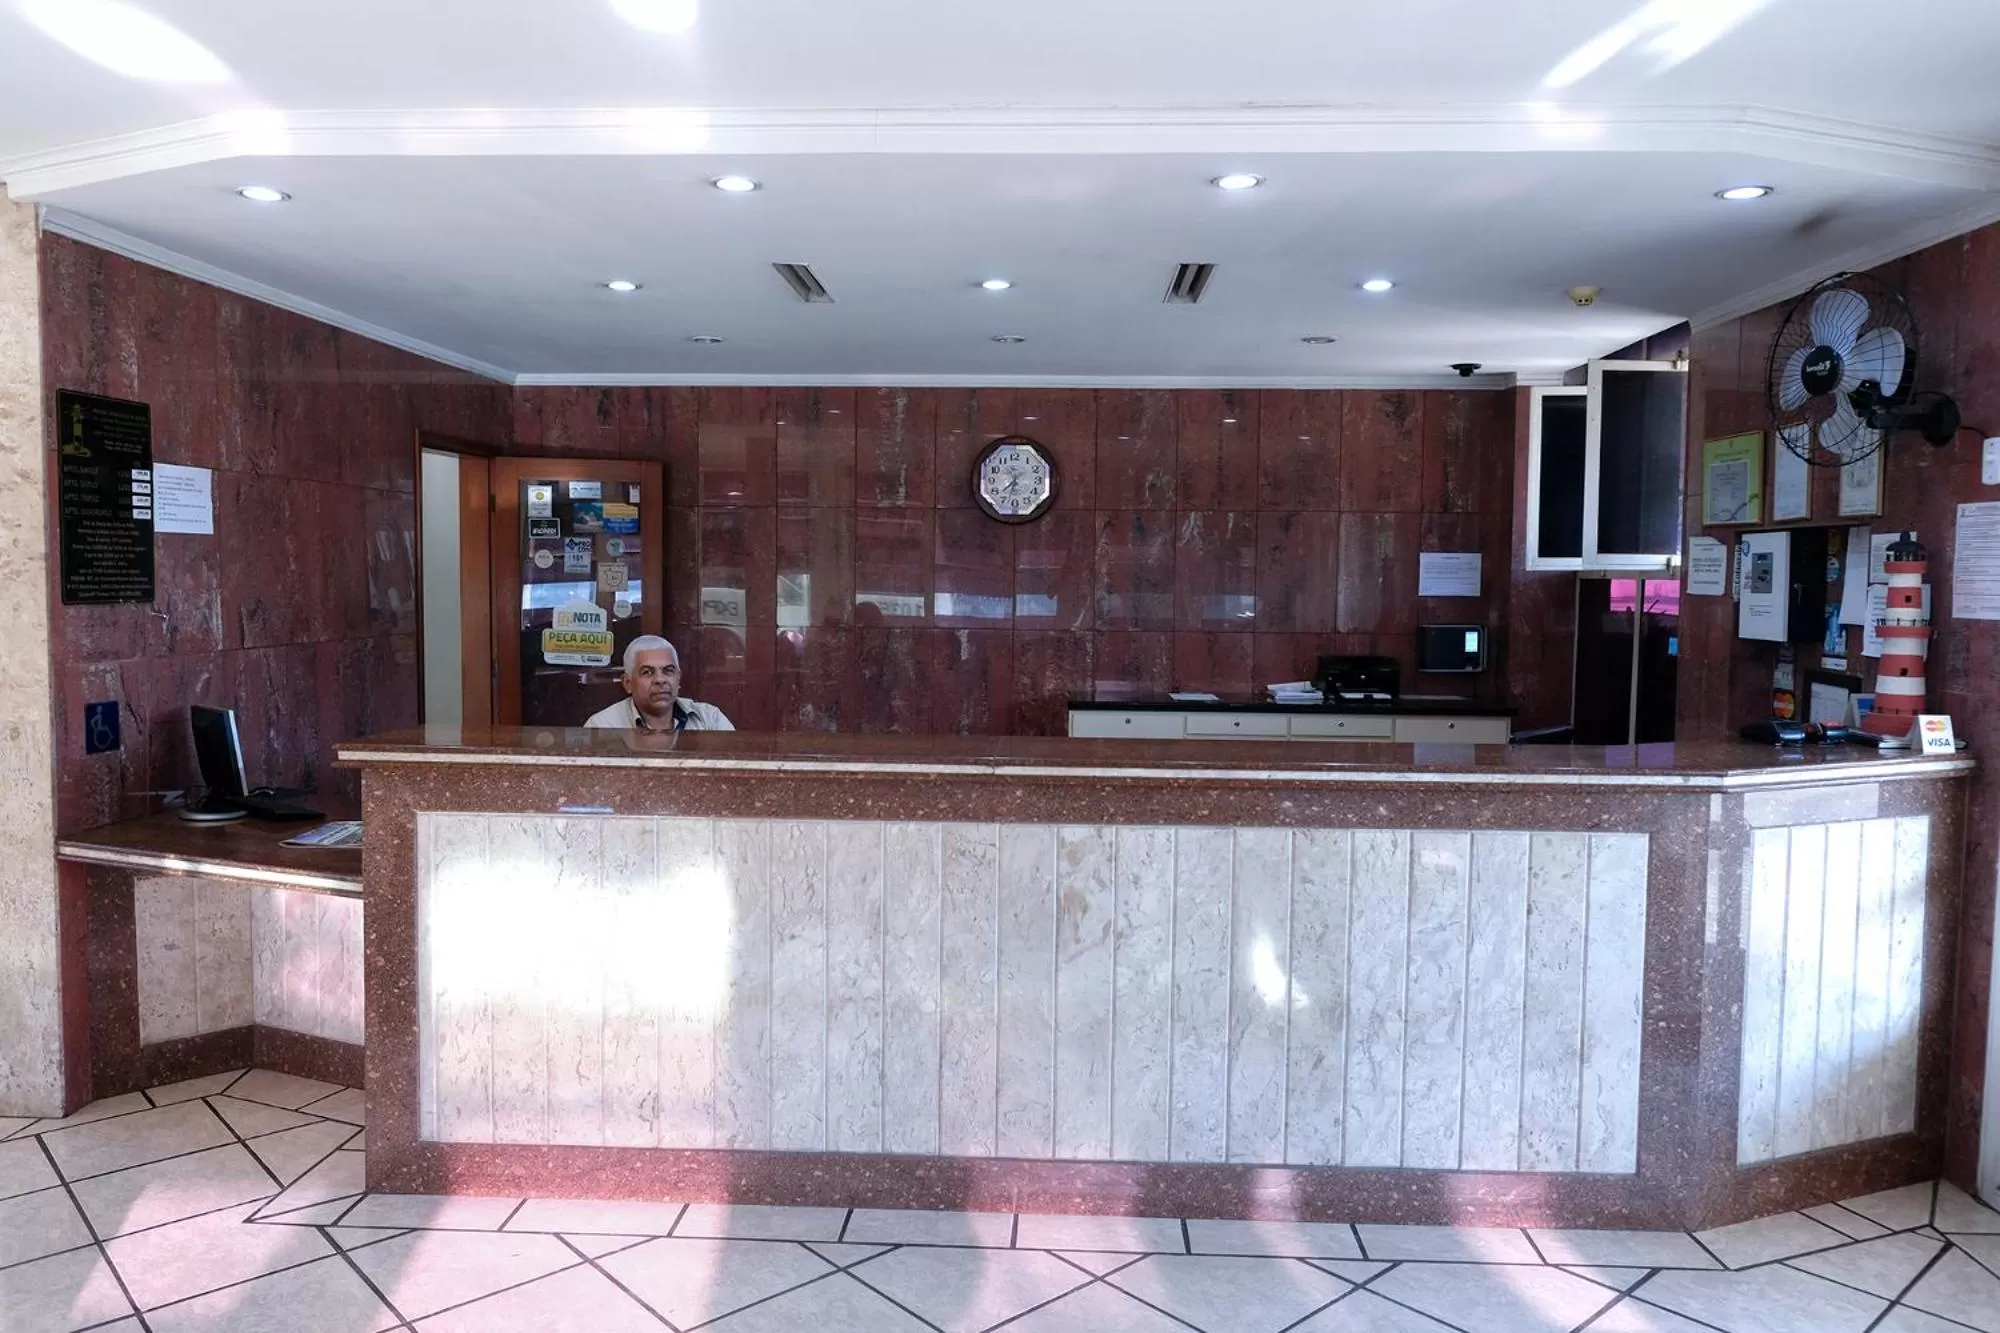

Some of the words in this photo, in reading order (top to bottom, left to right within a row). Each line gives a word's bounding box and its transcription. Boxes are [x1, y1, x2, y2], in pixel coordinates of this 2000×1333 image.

[1010, 453, 1020, 461] 12
[991, 466, 1000, 474] 10
[1031, 466, 1040, 474] 2
[1034, 476, 1041, 485] 3
[1000, 496, 1007, 504] 7
[1012, 499, 1019, 507] 6
[1023, 496, 1031, 504] 5
[573, 612, 602, 624] NOTA
[548, 632, 577, 644] PEÇA
[580, 634, 607, 644] AQUI
[1928, 738, 1952, 747] VISA
